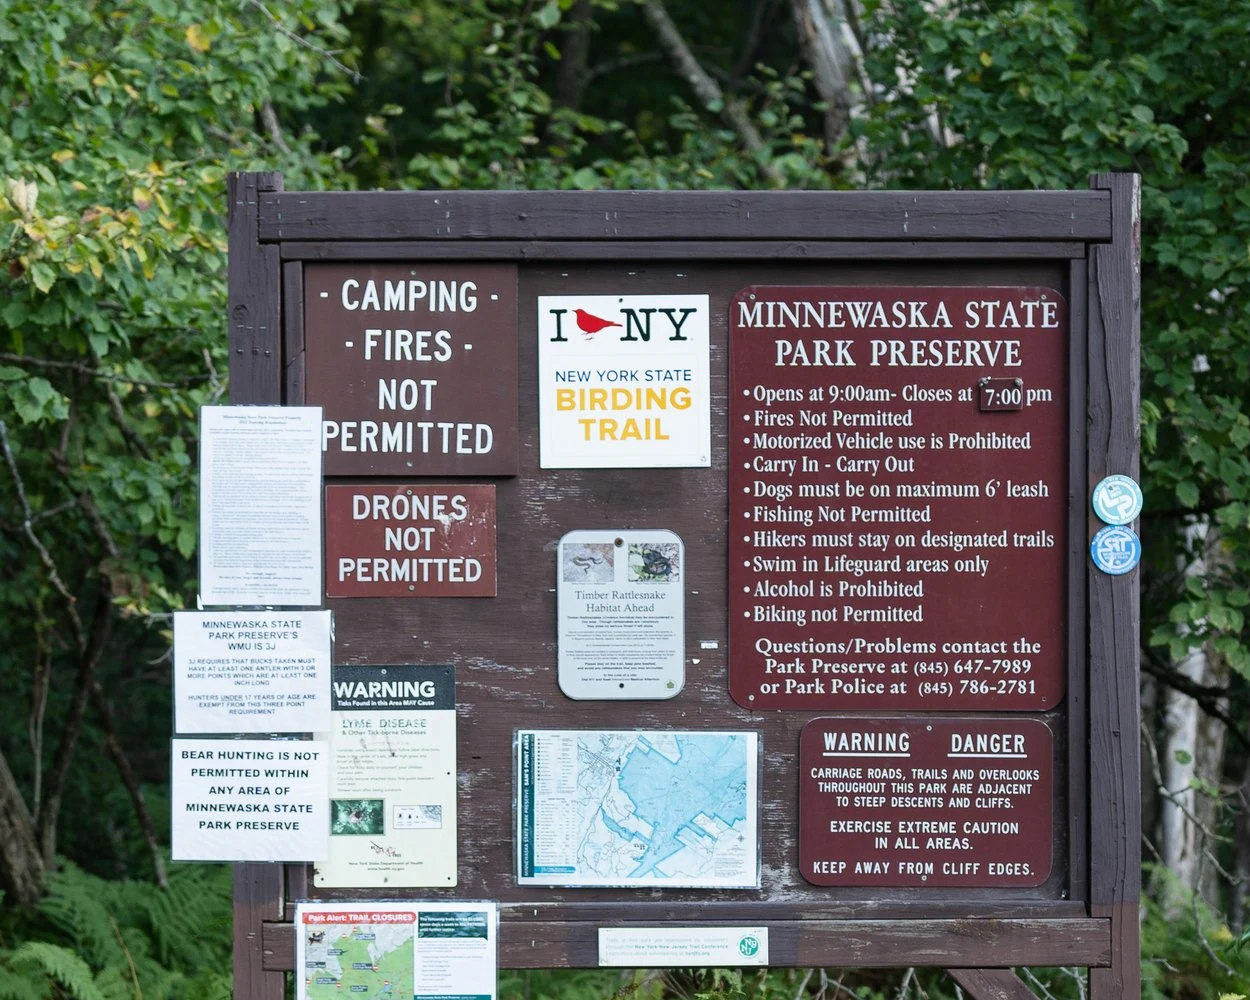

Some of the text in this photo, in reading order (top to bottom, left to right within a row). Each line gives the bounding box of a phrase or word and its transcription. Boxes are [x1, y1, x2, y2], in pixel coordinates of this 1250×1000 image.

[341, 280, 478, 313] CAMPING
[738, 301, 1059, 328] MINNEWASKA STATE
[549, 307, 697, 342] I NY
[364, 329, 452, 361] FIRES
[775, 340, 1022, 366] PARK PRESERVE
[555, 369, 692, 383] NEW YORK STATE
[378, 380, 436, 410] NOT
[556, 387, 692, 410] BIRDING
[753, 386, 803, 406] Opens
[809, 387, 824, 401] at
[902, 386, 952, 401] Closes
[958, 387, 972, 401] at
[986, 389, 1021, 405] 7:00
[1026, 388, 1052, 406] pm
[579, 417, 670, 440] TRAIL
[322, 422, 494, 454] PERMITTED
[353, 495, 467, 520] DRONES
[753, 506, 931, 526] Fishing Not Permitted
[384, 527, 435, 551] NOT
[753, 530, 1054, 551] Hikers must stay on designated trails
[338, 558, 482, 582] PERMITTED
[575, 590, 666, 600] Timber Rattlesnake
[587, 603, 654, 612] Habitat Ahead
[755, 638, 1040, 656] Questions/Problems contact the
[765, 659, 1031, 675] Park Preserve at (845) 647-7989
[334, 681, 435, 698] WARNING
[760, 679, 1036, 696] or Park Police at (845) 786-2781
[342, 719, 426, 728] LYME DISEASE
[824, 733, 1025, 752] WARNING DANGER
[182, 751, 213, 759] BEAR
[218, 752, 274, 760] HUNTING
[279, 752, 289, 760] IS
[191, 769, 260, 777] PERMITTED
[811, 768, 1039, 780] CARRIAGE ROADS, TRAILS AND OVERLOOKS
[239, 787, 270, 795] AREA
[275, 787, 290, 795] OF
[819, 782, 1032, 794] THROUGHOUT THIS PARK ARE ADJACENT
[186, 804, 312, 813] MINNEWASKA STATE
[837, 796, 1014, 808] TO STEEP DESCENTS AND CLIFFS.
[199, 821, 300, 830] PARK PRESERVE
[830, 821, 1018, 834] EXERCISE EXTREME CAUTION
[875, 838, 973, 849] IN ALL AREAS.
[813, 862, 1034, 875] KEEP AWAY FROM CLIFF EDGES.
